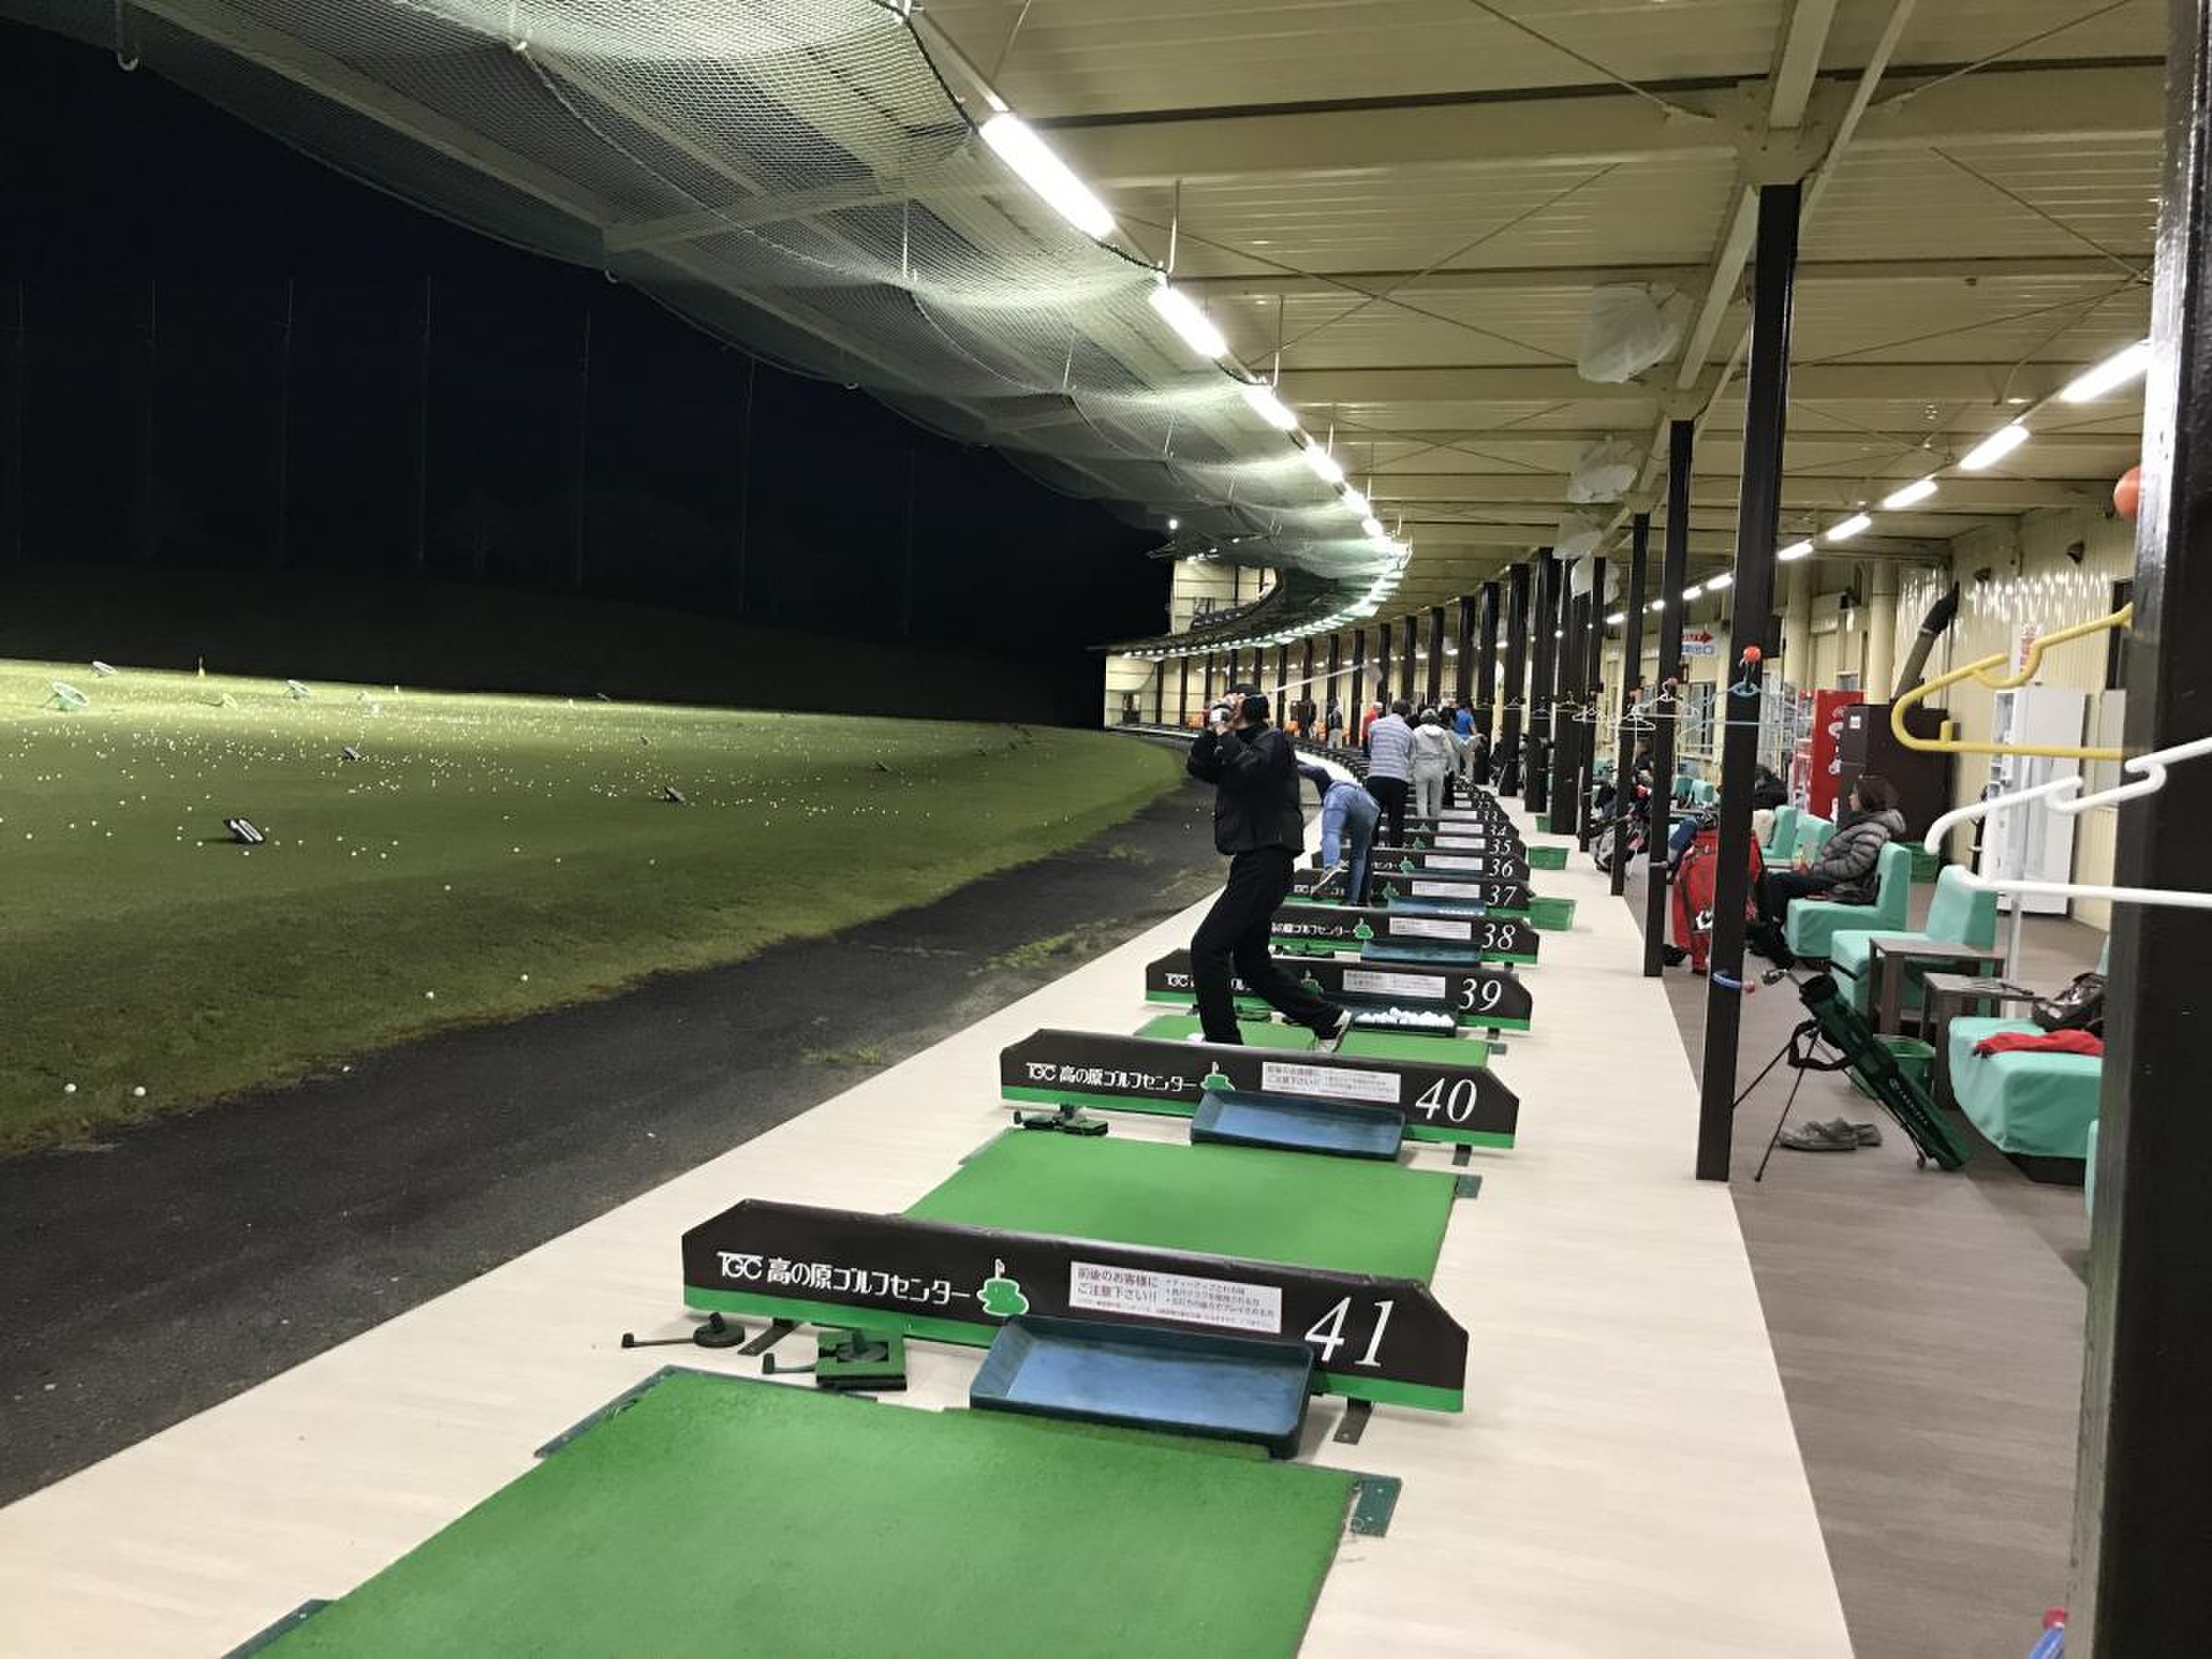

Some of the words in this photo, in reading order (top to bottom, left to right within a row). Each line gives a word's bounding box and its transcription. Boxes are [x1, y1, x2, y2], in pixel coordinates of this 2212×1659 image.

[1488, 838, 1512, 855] 35
[1488, 857, 1514, 878] 36
[1488, 884, 1519, 907] 37
[1480, 922, 1516, 950] 38
[1459, 977, 1503, 1010] 39
[1059, 1065, 1197, 1092] 高の原ゴルフセンター
[1415, 1077, 1477, 1123] 40
[716, 1251, 764, 1281] TGC
[766, 1256, 971, 1305] 高の原ゴルフセンター
[1304, 1296, 1394, 1368] 41
